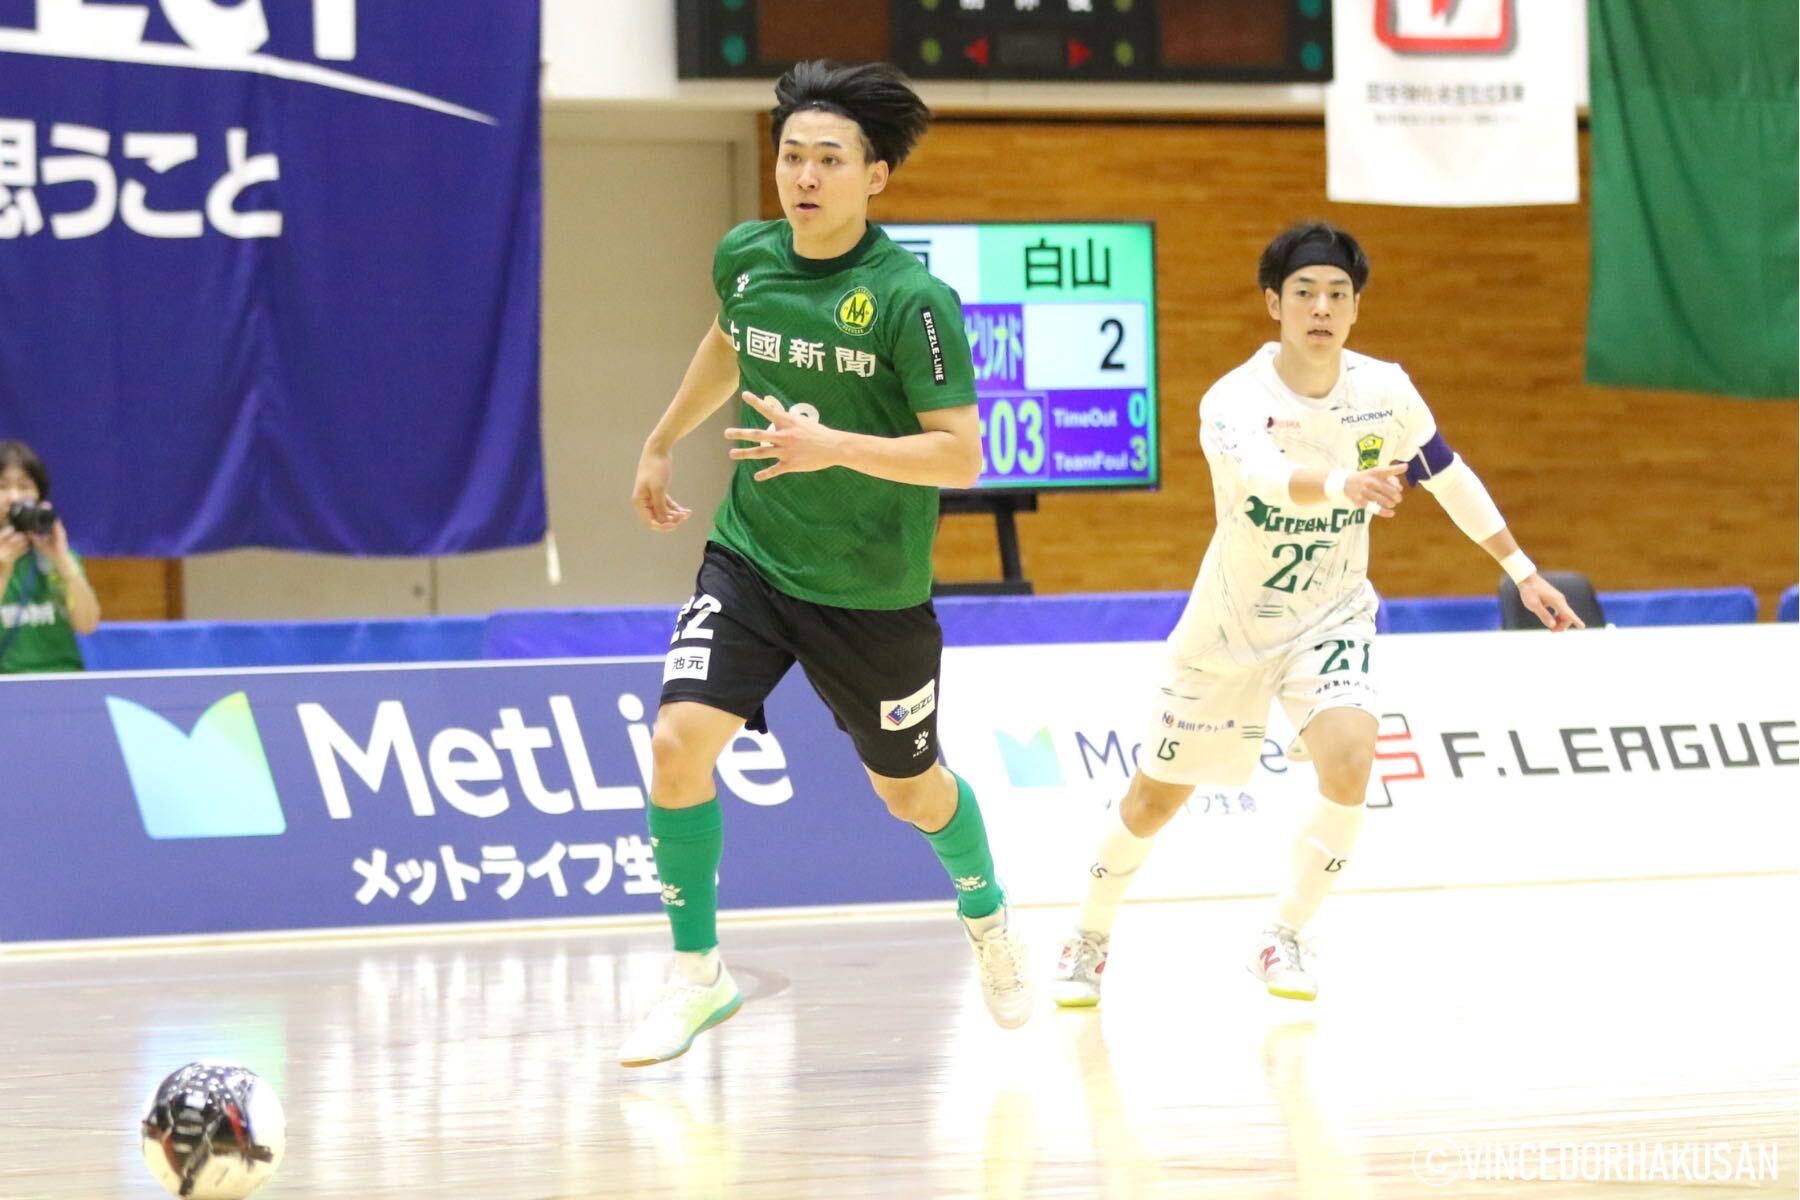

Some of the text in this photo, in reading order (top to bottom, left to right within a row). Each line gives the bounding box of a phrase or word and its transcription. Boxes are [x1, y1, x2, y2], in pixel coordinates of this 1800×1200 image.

[1025, 238, 1111, 290] 白山
[922, 311, 945, 382] EXIZZLE-LINE
[1099, 318, 1126, 371] 2
[1052, 391, 1147, 429] TimeOut 0
[1053, 435, 1148, 472] TeamFoul 3
[1262, 542, 1334, 593] 27
[672, 656, 704, 670] 池元
[296, 693, 795, 820] MetLie
[1440, 720, 1800, 779] F.LEAGUE
[352, 834, 719, 906] メットライフ生
